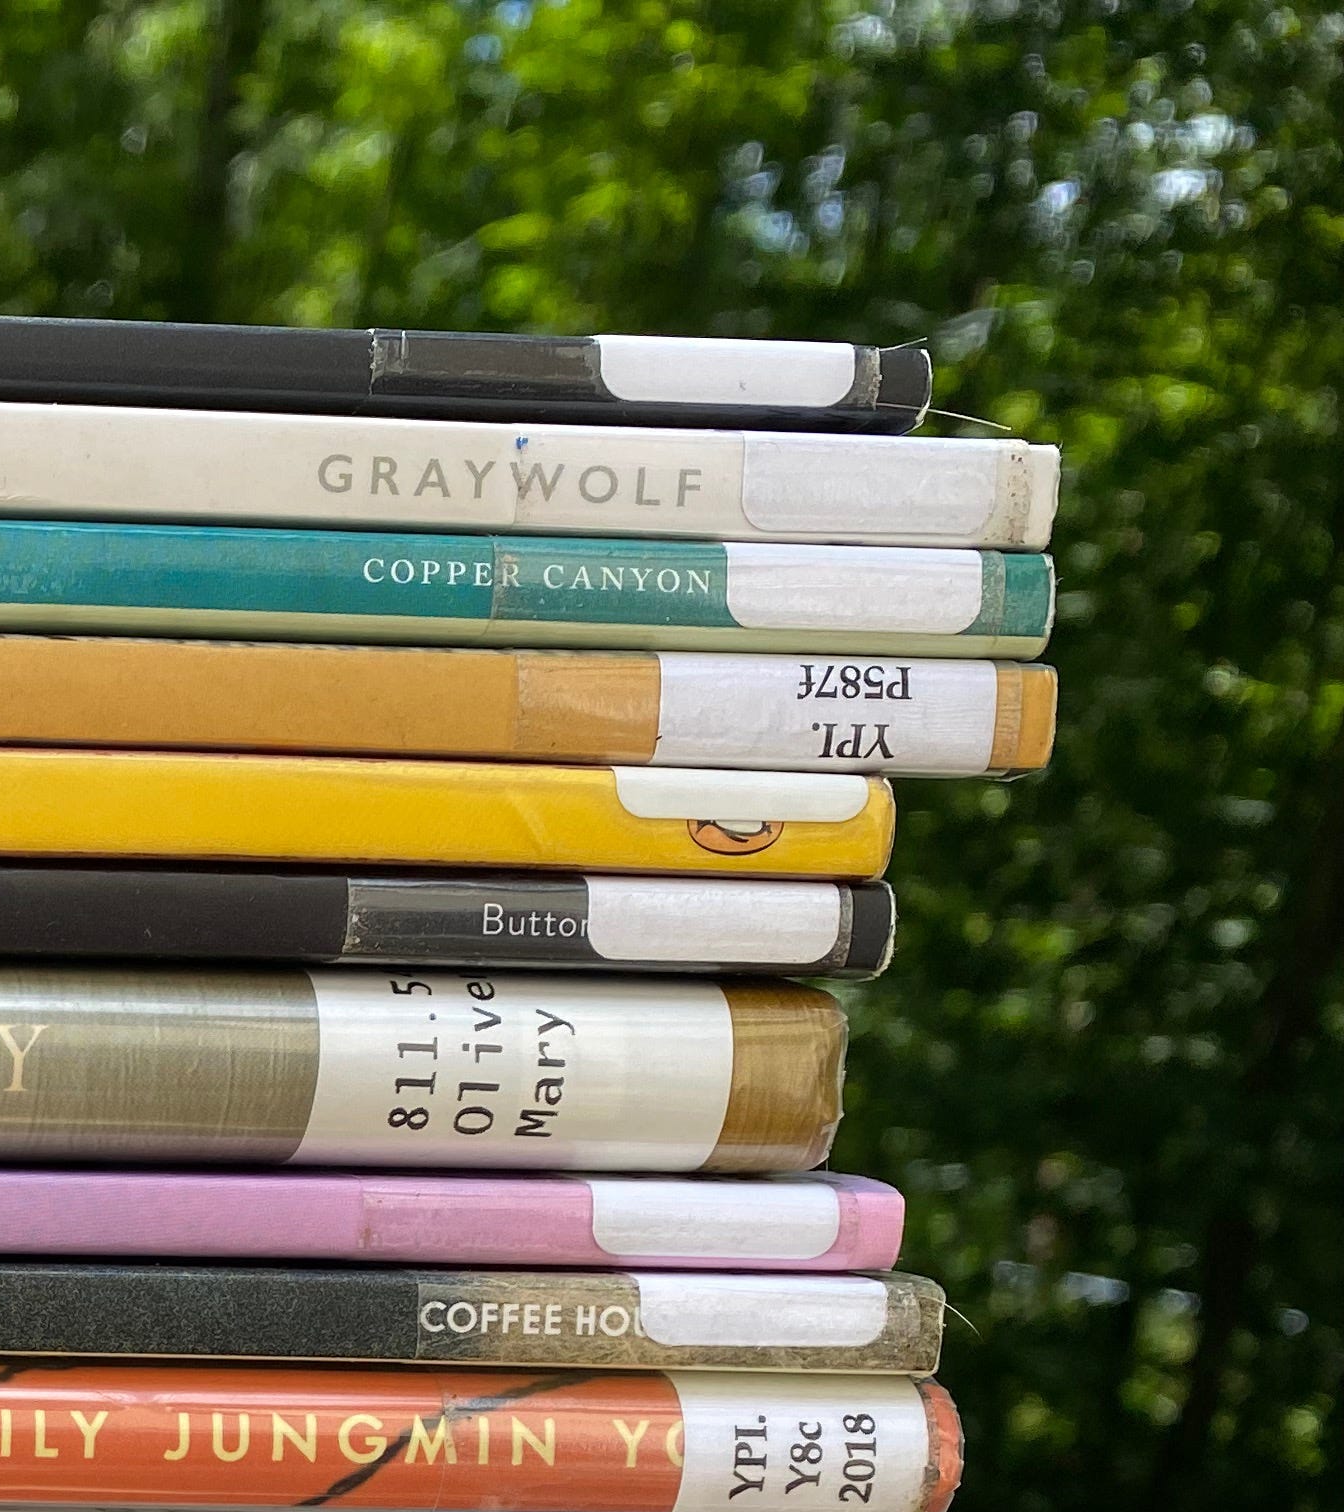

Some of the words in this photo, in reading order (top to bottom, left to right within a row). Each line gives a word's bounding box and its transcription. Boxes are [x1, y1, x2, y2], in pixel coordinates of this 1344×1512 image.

[318, 454, 703, 508] GRAYWOLF
[362, 557, 521, 589] COPPER
[543, 564, 711, 595] CANYON
[798, 665, 912, 702] P587f
[387, 970, 438, 1130] 811.5
[453, 973, 503, 1134] Olive
[514, 1008, 576, 1137] Mary
[421, 1301, 562, 1336] COFFEE
[162, 1410, 556, 1468] JUNGMIN
[785, 1420, 825, 1495] Y8c
[841, 1413, 877, 1504] 2018
